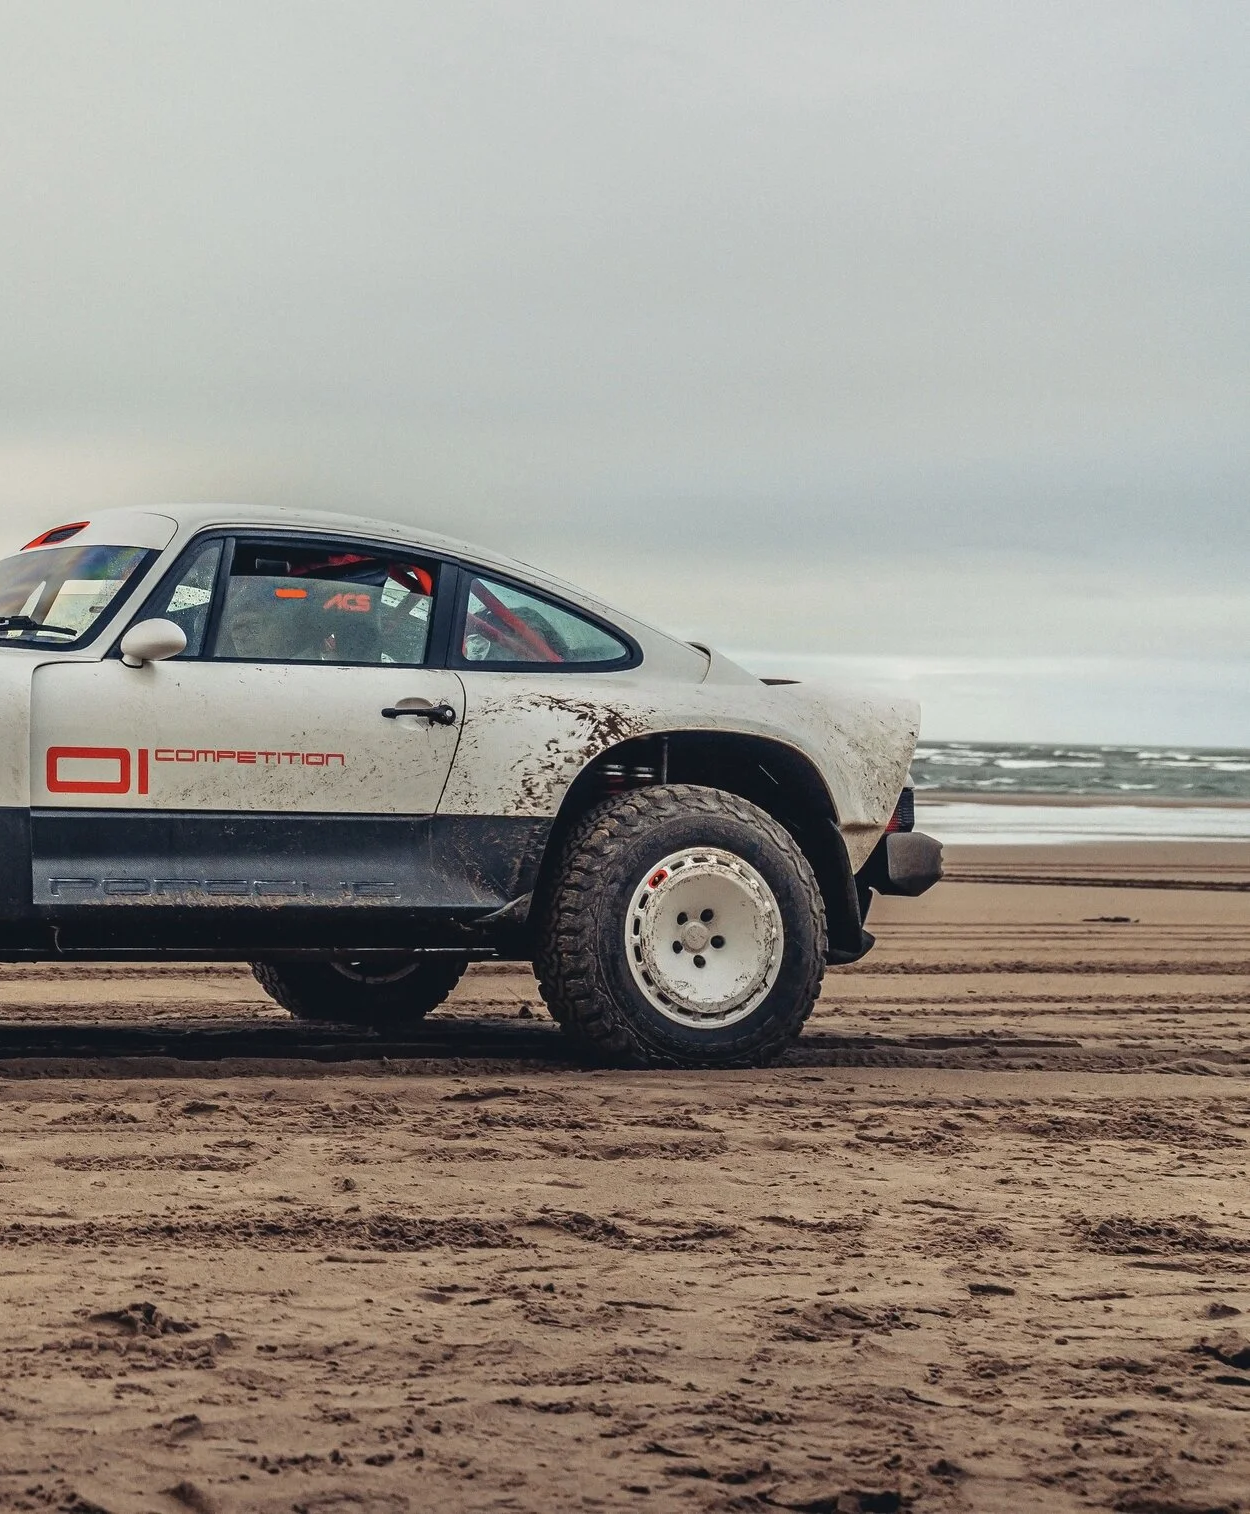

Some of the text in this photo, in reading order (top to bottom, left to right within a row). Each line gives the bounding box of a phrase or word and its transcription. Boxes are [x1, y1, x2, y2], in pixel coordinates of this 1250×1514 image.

[323, 593, 371, 612] ACS
[46, 746, 345, 794] 01 COMPETITION
[49, 877, 401, 899] PORSCHE
